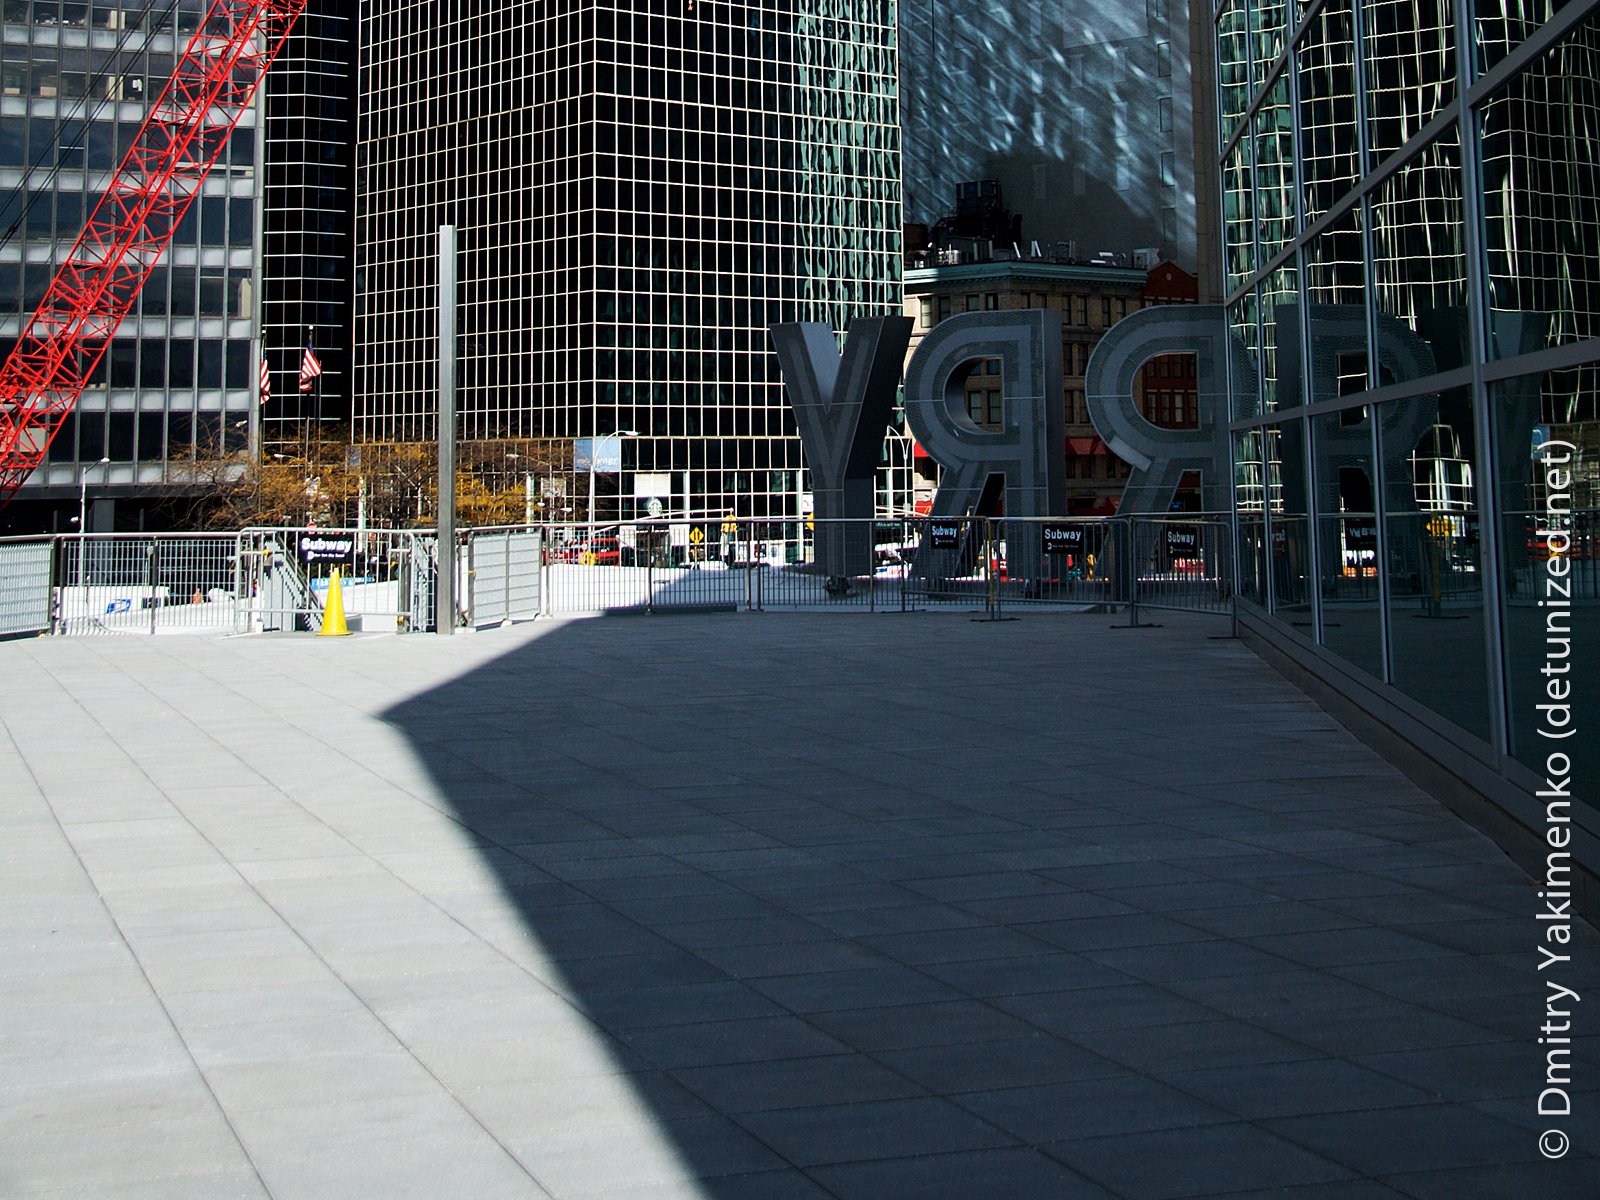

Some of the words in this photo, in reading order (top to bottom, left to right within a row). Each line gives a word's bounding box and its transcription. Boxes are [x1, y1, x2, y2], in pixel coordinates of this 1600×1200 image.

[931, 525, 957, 538] Subway
[1044, 528, 1082, 542] Subway
[1167, 531, 1195, 545] Subway
[301, 537, 353, 553] Subway
